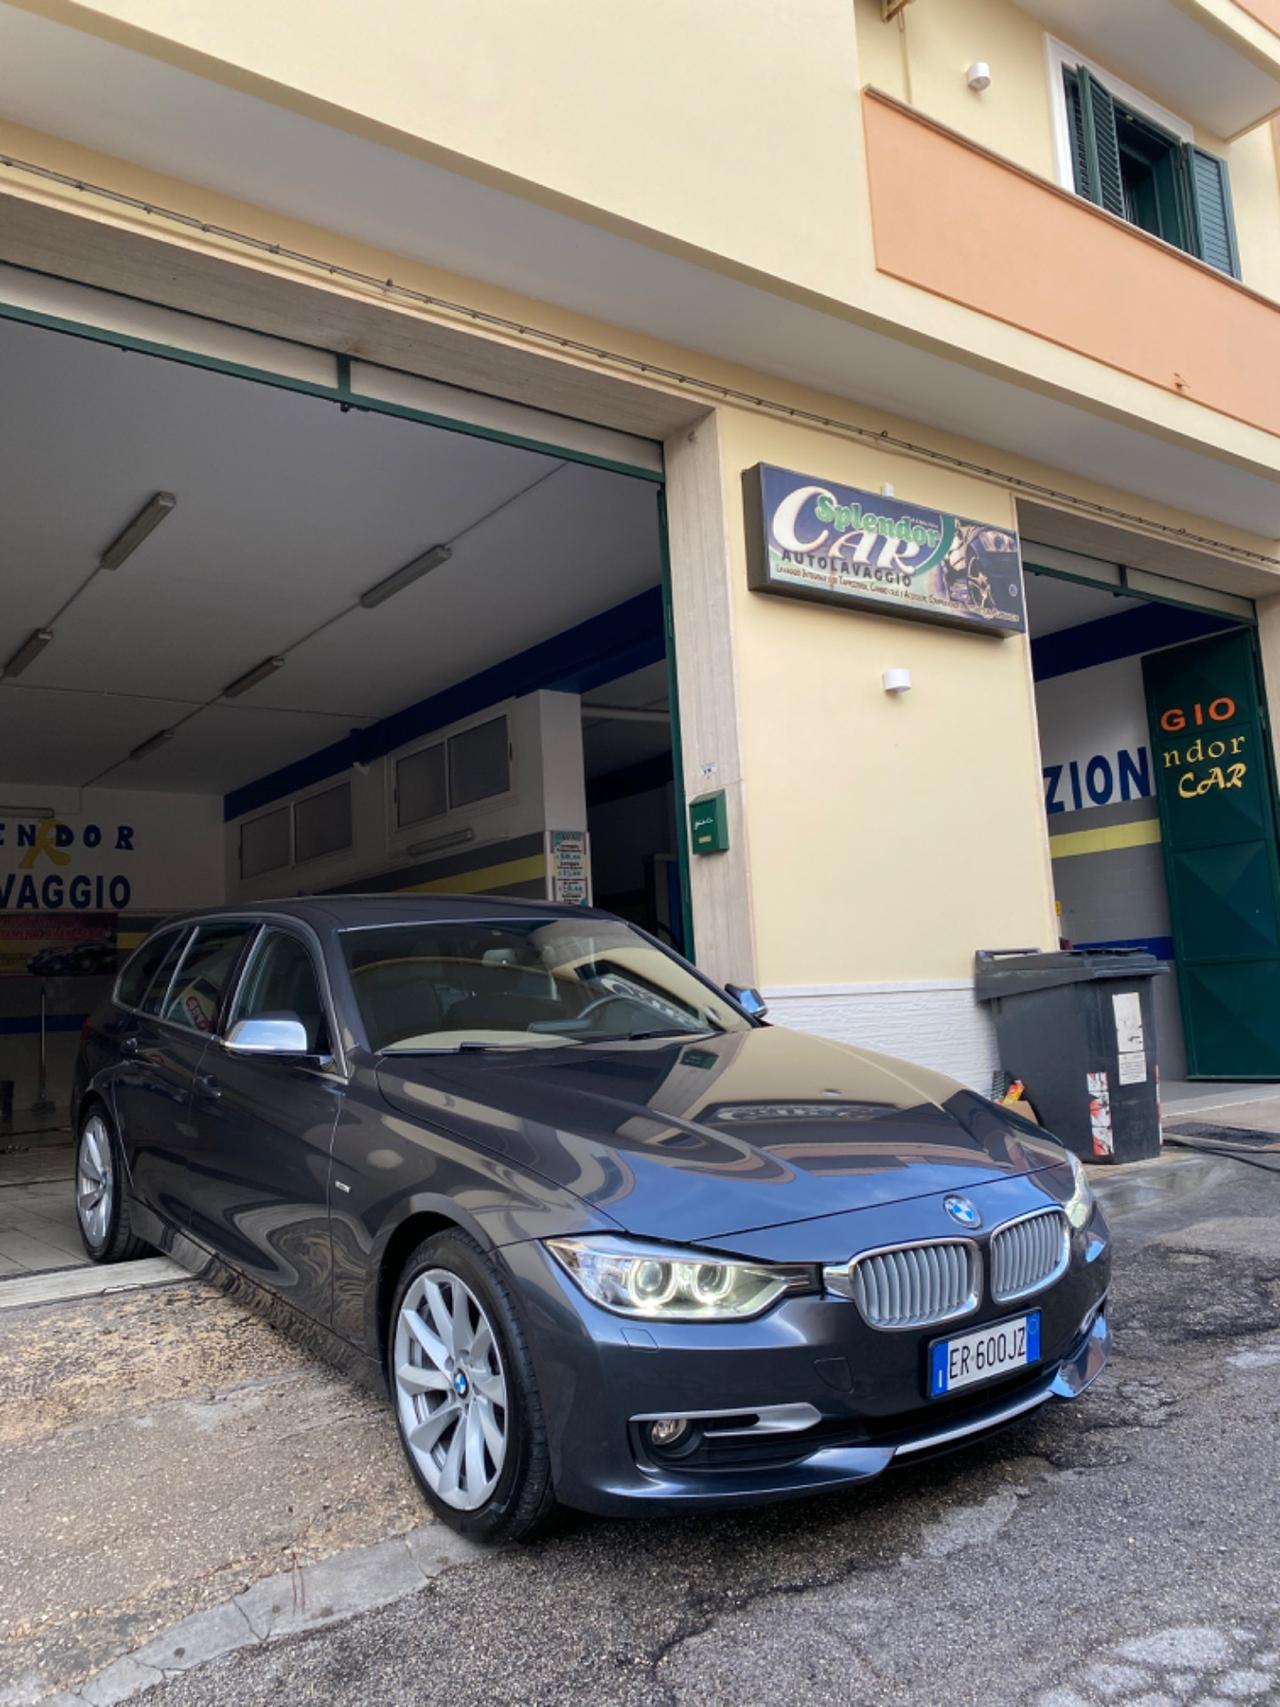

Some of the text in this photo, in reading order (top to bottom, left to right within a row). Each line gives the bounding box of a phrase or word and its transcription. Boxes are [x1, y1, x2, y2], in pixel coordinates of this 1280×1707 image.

[772, 485, 921, 574] CAR
[815, 494, 940, 547] Splendor
[781, 549, 912, 587] AUTOLAVAGGIO
[1160, 697, 1236, 732] GIO
[1163, 735, 1246, 768] ndor
[1043, 746, 1151, 814] ZION
[1178, 763, 1247, 799] CAR
[949, 1346, 970, 1379] ER
